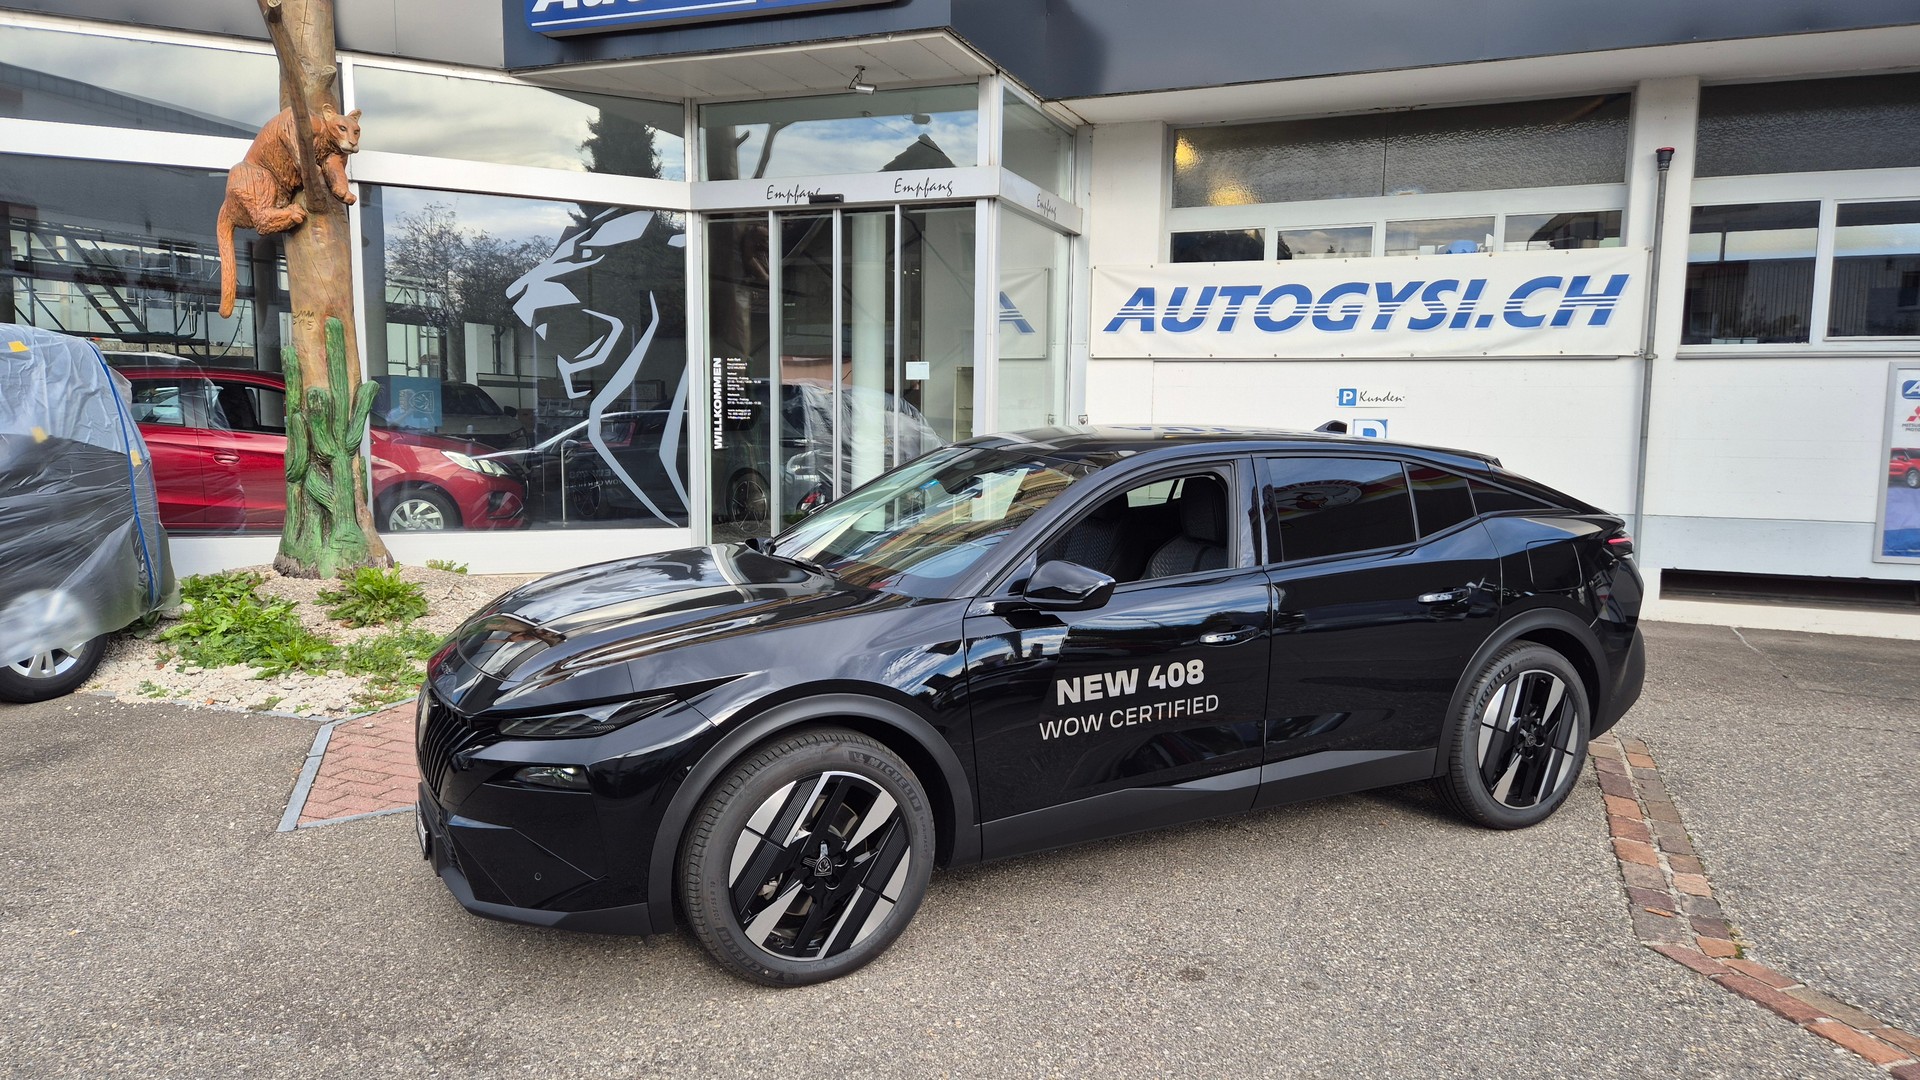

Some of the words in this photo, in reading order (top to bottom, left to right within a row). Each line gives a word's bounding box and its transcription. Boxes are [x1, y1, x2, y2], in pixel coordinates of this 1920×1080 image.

[894, 177, 953, 198] Empfang
[1037, 193, 1057, 220] Empfang
[1103, 273, 1630, 333] AUTOGYSI.CH
[713, 357, 723, 449] WILLKOMMEN
[1342, 390, 1353, 404] P
[1359, 390, 1403, 402] Kunden
[1057, 668, 1139, 705] NEW
[1148, 659, 1205, 690] 408
[1475, 664, 1511, 717] MICHELIN
[1039, 713, 1103, 740] WOW
[1109, 694, 1219, 729] CERTIFIED
[867, 757, 921, 811] MICHELIN
[717, 928, 782, 979] MICHELIN
